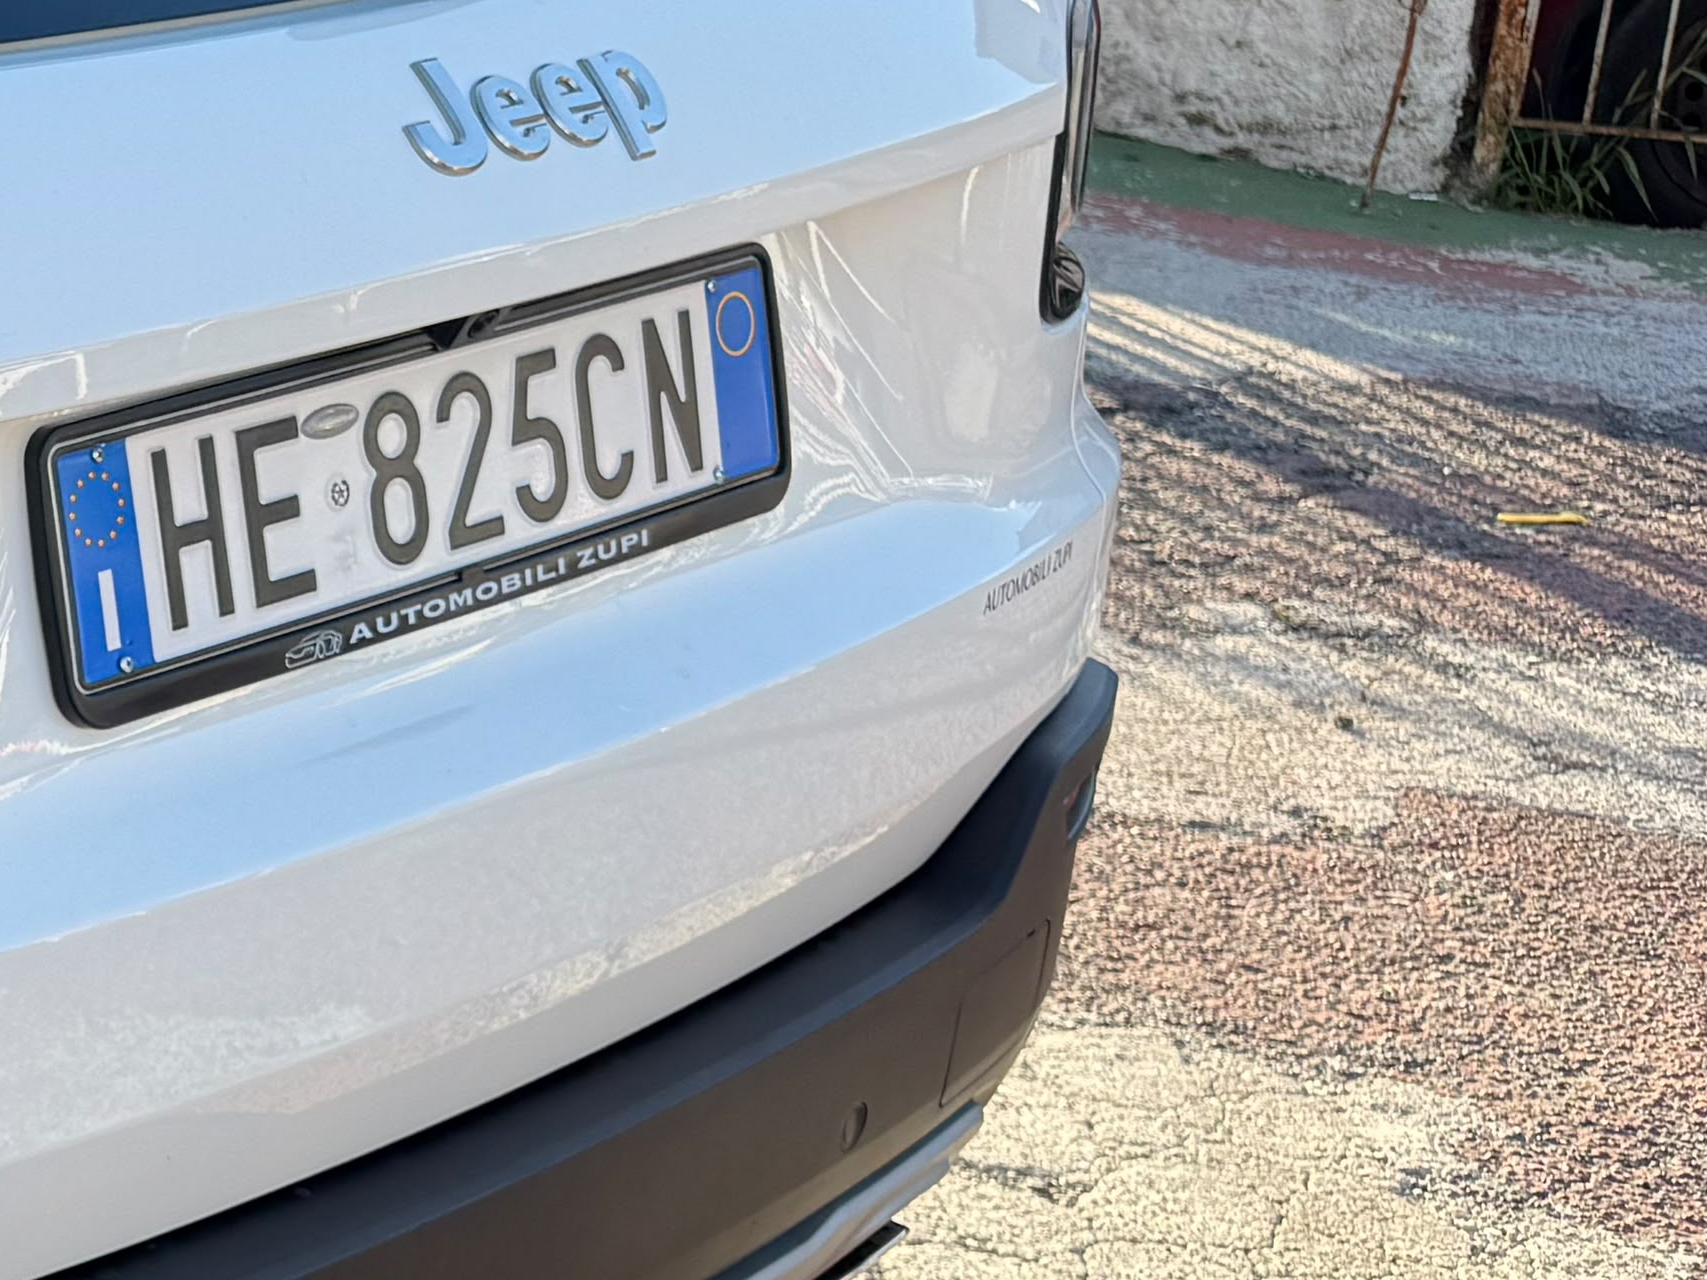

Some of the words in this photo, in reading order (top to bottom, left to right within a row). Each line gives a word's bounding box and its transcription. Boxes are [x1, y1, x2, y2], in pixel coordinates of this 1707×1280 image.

[402, 50, 668, 177] Jeep
[150, 416, 317, 631] HE
[363, 309, 704, 566] 825CN
[97, 569, 122, 652] I
[349, 557, 567, 645] AUTOMOBILI
[577, 529, 650, 569] ZUPI
[983, 556, 1051, 615] AUTOMOBILI
